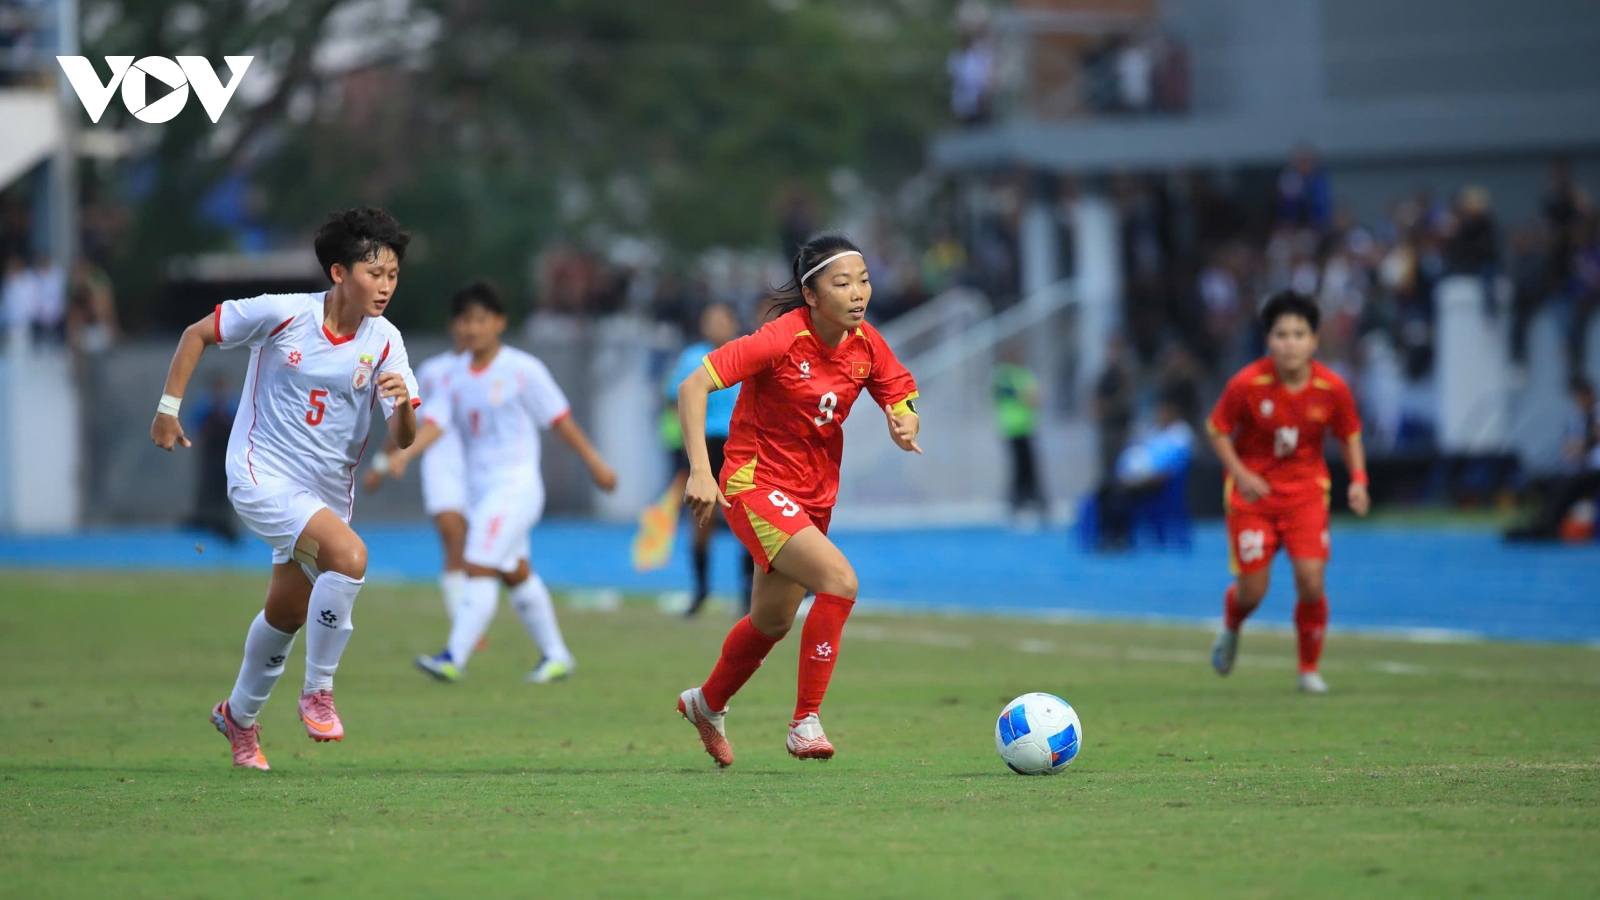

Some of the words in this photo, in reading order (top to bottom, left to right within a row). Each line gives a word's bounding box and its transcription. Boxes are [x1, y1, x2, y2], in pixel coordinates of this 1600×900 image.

[305, 389, 328, 426] 5
[814, 391, 838, 427] 9
[768, 489, 800, 518] 9
